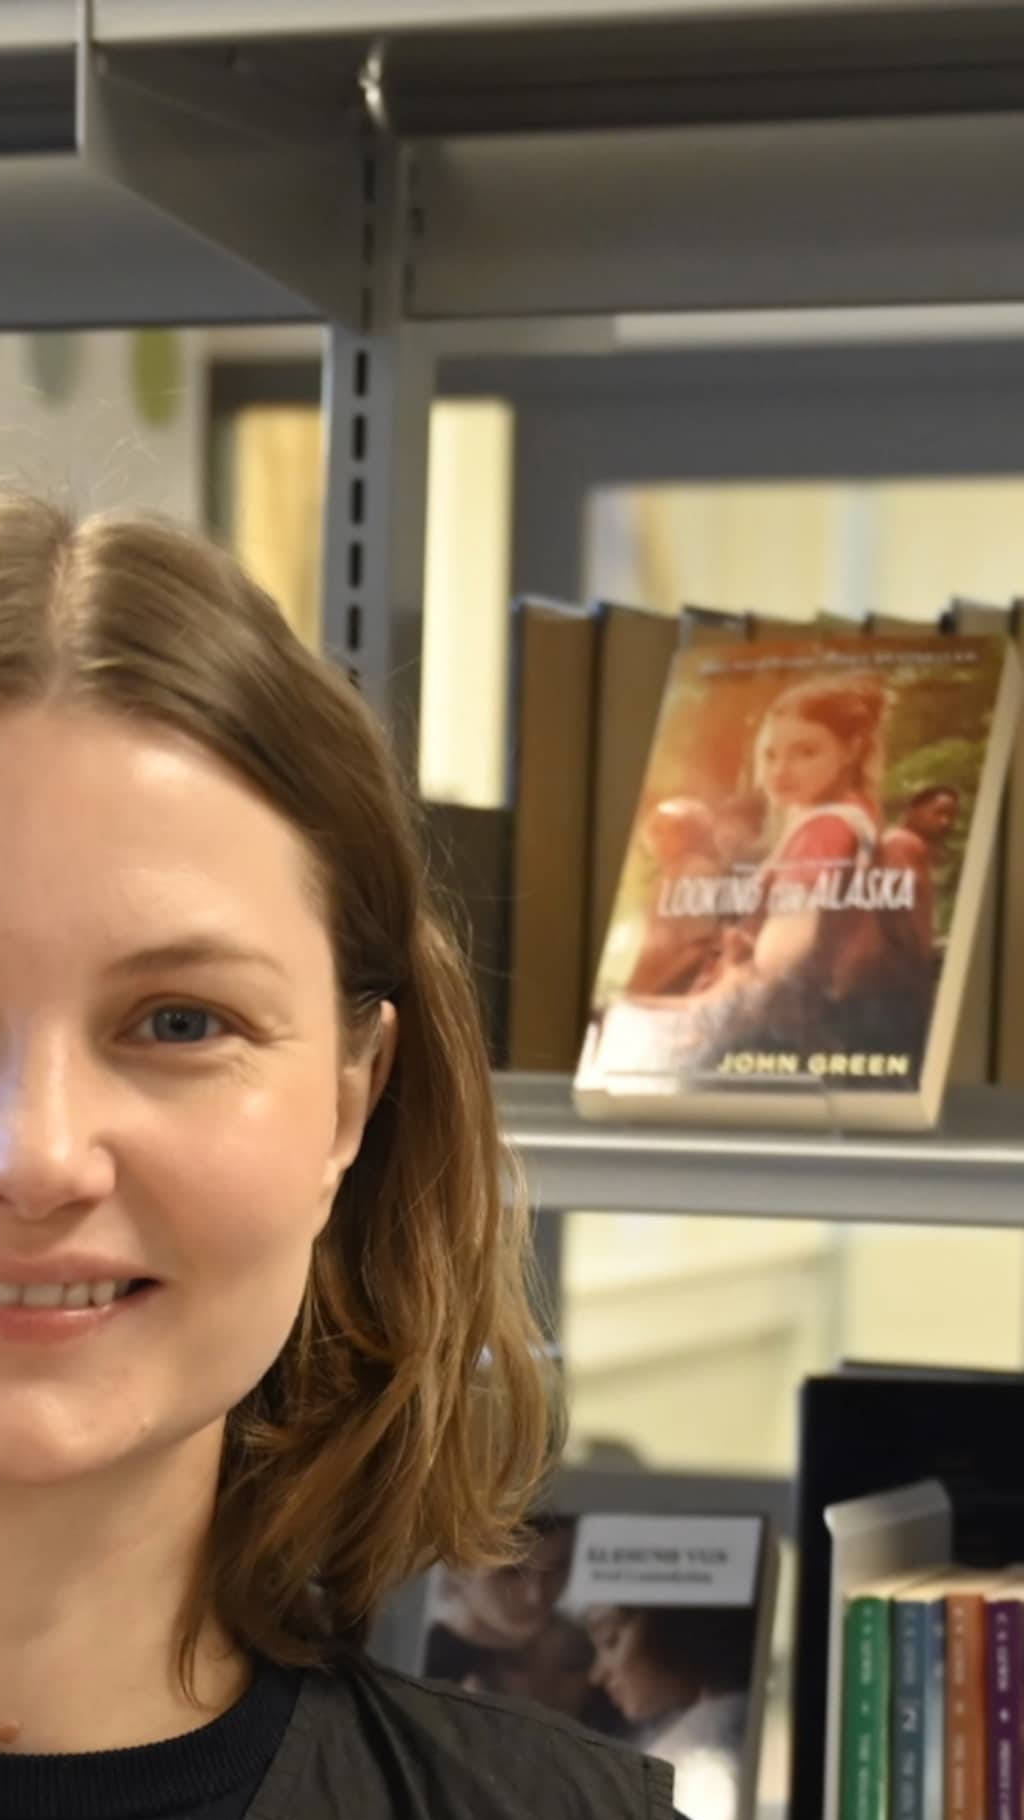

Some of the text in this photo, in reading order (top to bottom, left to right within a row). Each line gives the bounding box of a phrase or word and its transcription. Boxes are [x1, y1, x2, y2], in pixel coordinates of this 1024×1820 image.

[658, 873, 762, 919] LOOKING
[807, 865, 915, 911] ALASKA
[718, 1051, 910, 1078] JOHN GREEN
